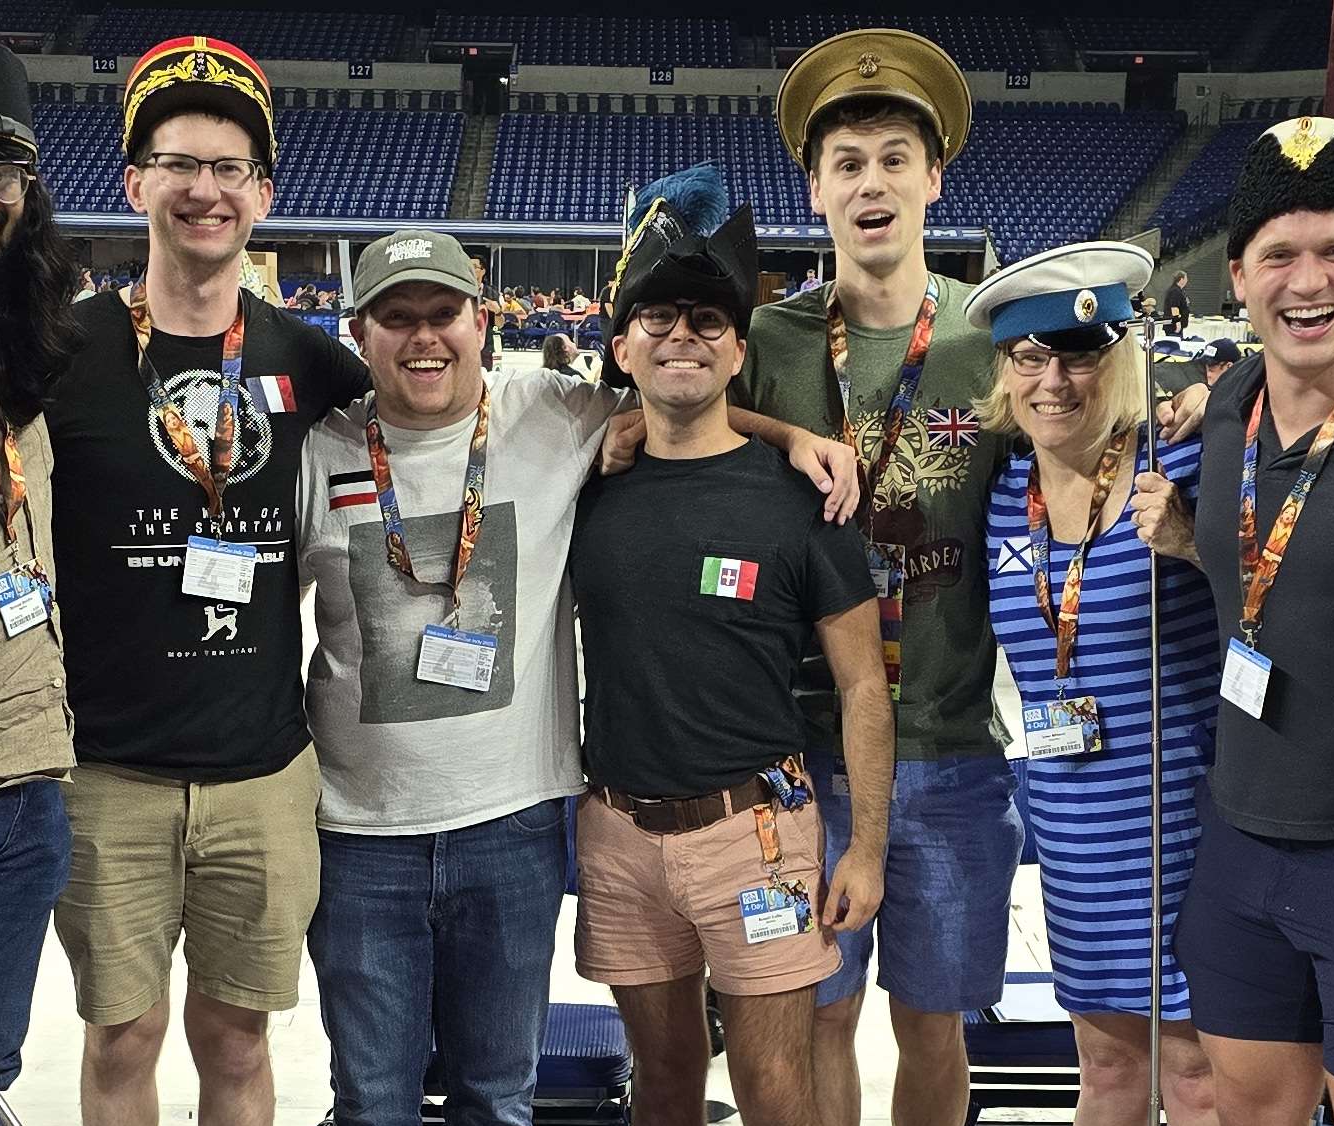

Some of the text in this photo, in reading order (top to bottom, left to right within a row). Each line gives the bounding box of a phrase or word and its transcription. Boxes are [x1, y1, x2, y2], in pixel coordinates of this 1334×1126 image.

[94, 59, 116, 70] 126
[349, 65, 371, 76] 127
[651, 70, 673, 82] 128
[1008, 75, 1030, 87] 129
[137, 507, 280, 521] THE WY OF
[129, 520, 282, 536] THE SPARTAN
[128, 556, 154, 568] BE
